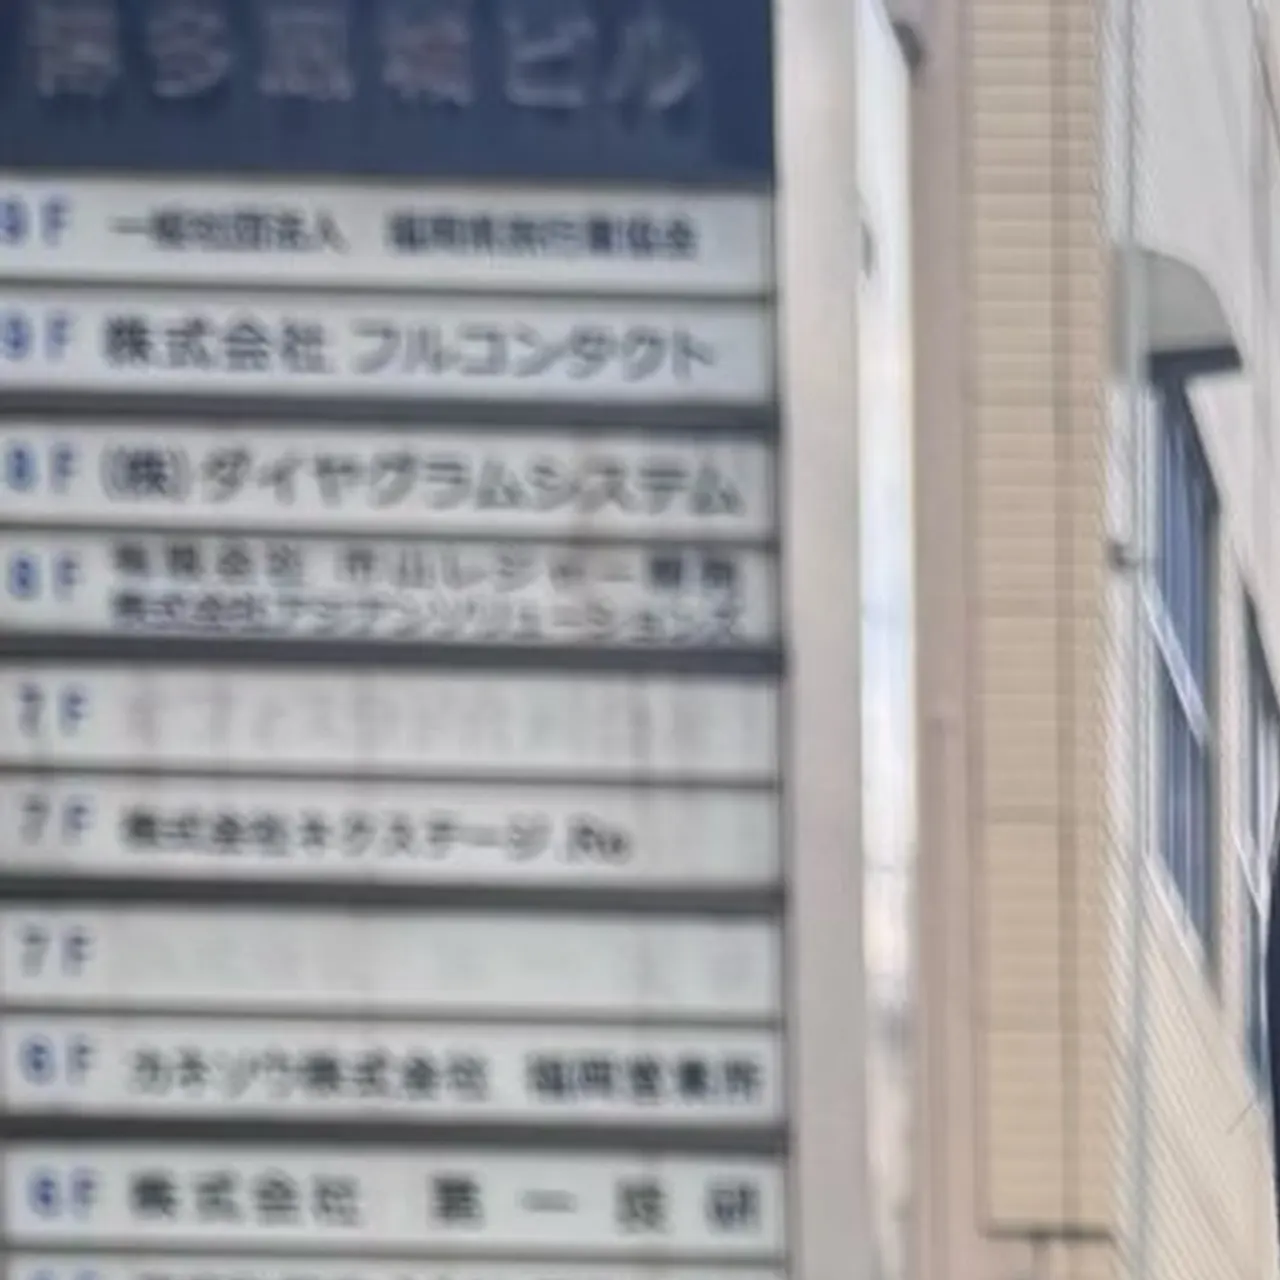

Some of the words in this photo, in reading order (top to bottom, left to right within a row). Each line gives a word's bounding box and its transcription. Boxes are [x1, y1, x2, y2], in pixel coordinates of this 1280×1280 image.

[102, 315, 332, 374] 株式会社
[350, 320, 713, 382] フルコンタクト
[129, 1167, 363, 1229] 株式会社
